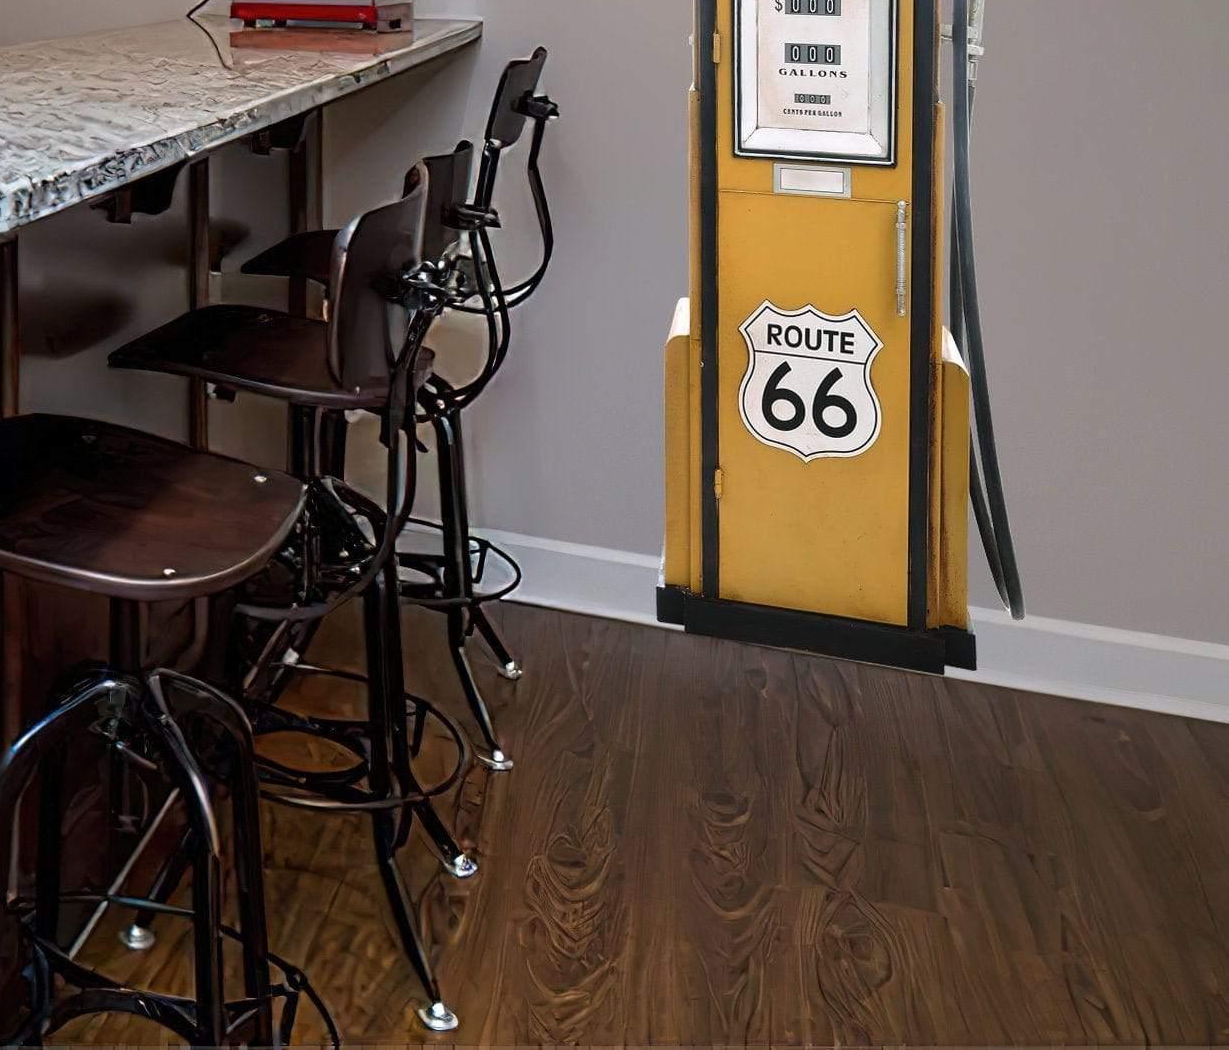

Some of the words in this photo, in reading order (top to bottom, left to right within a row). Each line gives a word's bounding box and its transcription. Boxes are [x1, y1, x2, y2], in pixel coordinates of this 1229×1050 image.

[778, 68, 848, 79] GALLONS
[767, 324, 855, 355] ROUTE
[761, 361, 858, 439] 66
